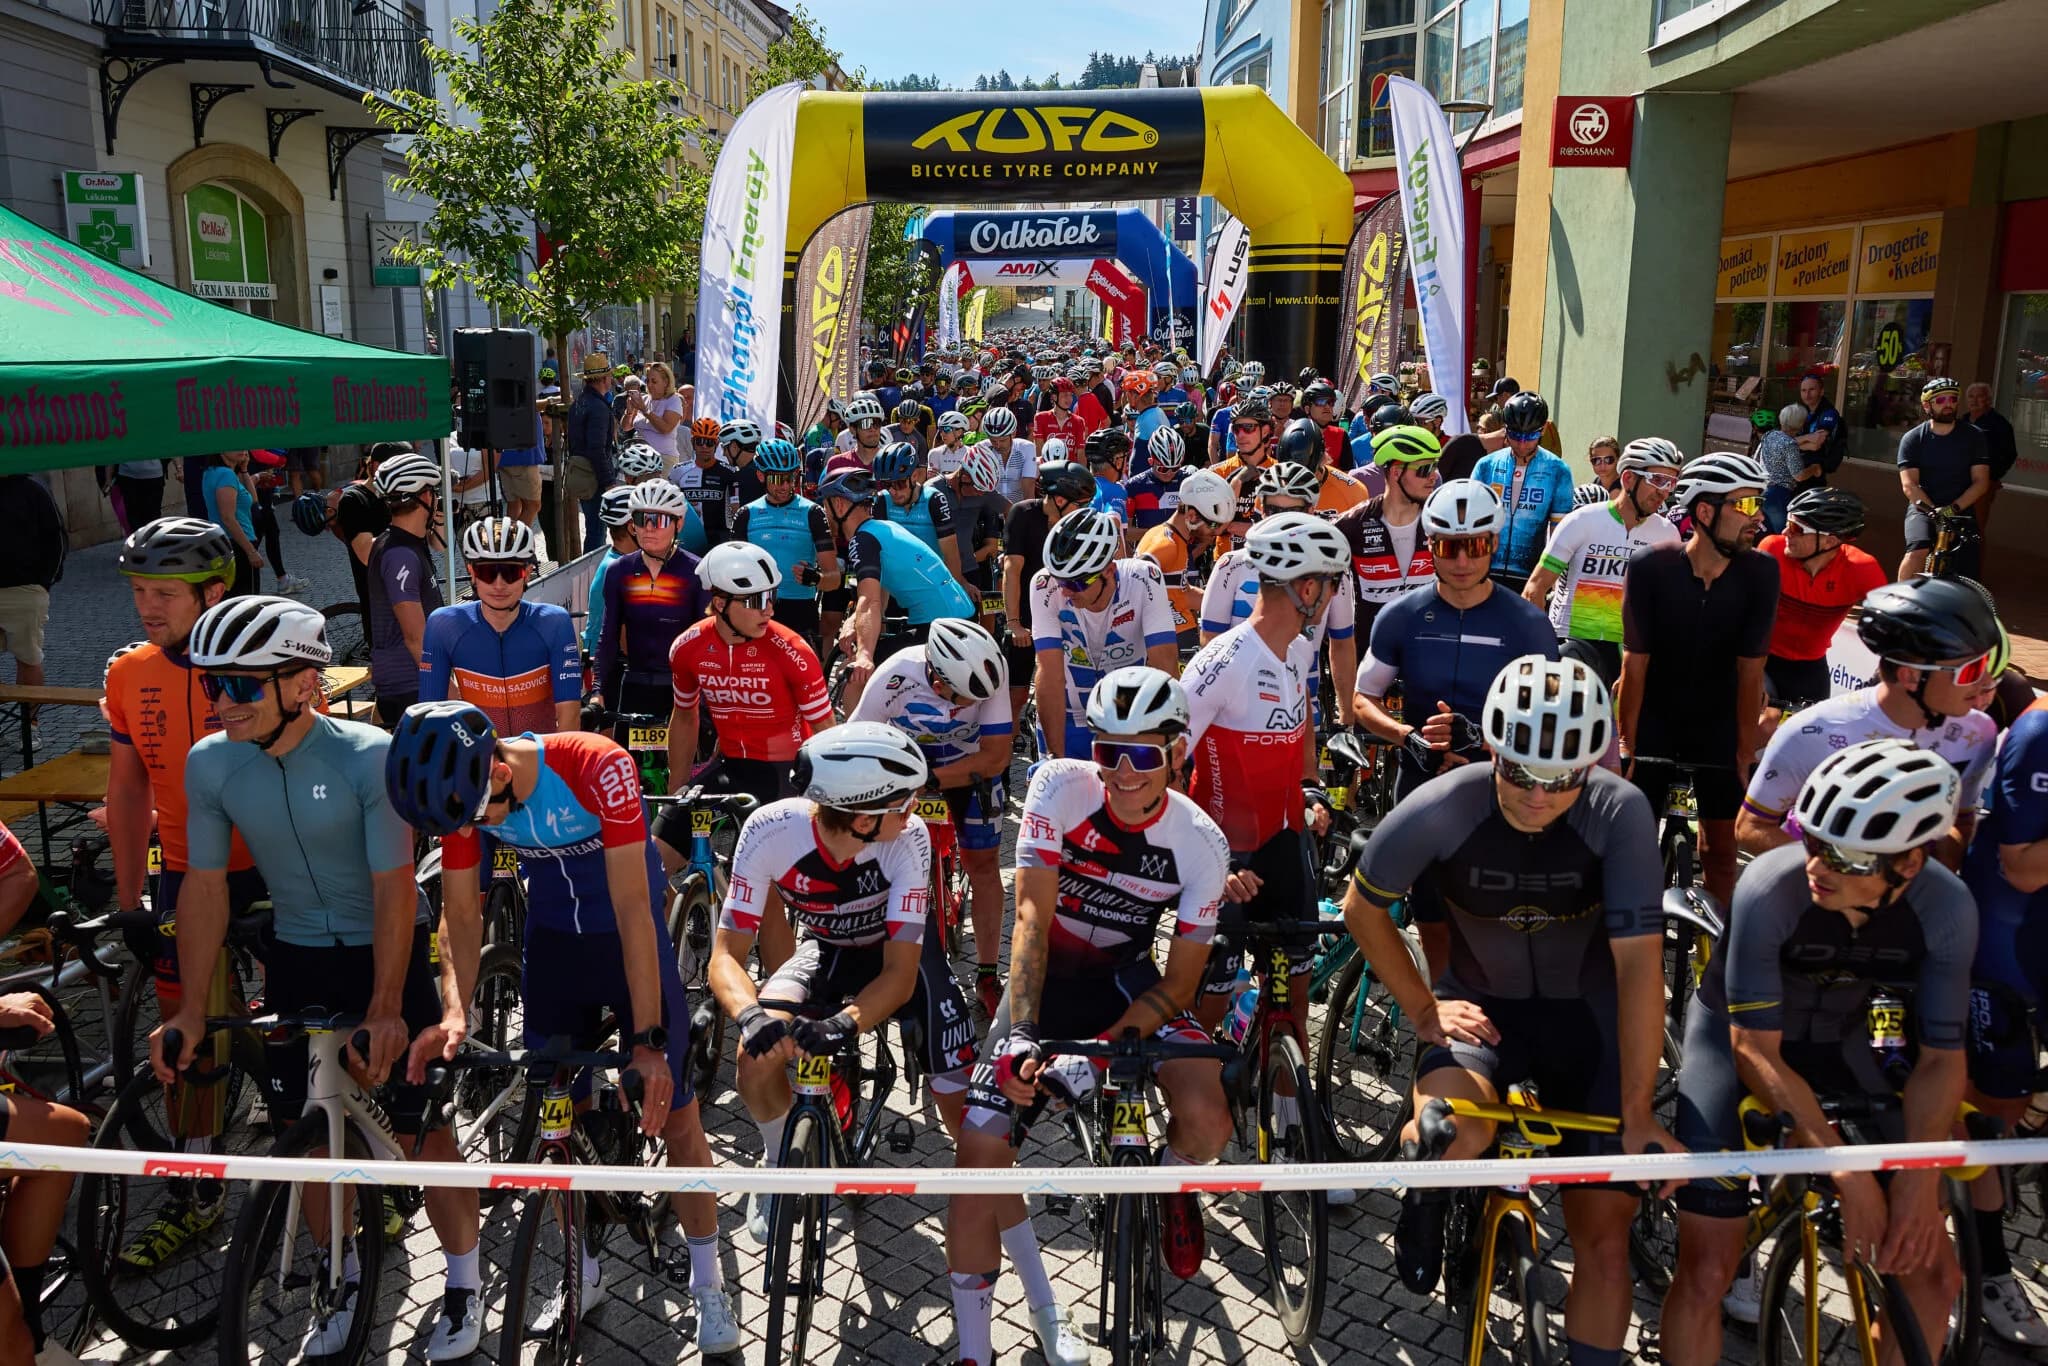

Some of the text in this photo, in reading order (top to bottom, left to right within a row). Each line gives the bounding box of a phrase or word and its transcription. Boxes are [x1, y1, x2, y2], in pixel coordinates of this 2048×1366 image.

[1559, 146, 1615, 157] ROSSMANN
[911, 161, 1159, 178] BICYCLE TYRE COMPANY
[85, 177, 116, 187] Dr.Max
[731, 148, 770, 283] Energy
[201, 220, 227, 237] Dr.Max
[969, 214, 1100, 253] Odkolek
[1784, 240, 1830, 270] Záclony
[1868, 226, 1929, 265] Drogerie
[1730, 261, 1769, 294] potřeby
[1798, 254, 1849, 287] Povlečení
[224, 285, 237, 297] NA
[1153, 324, 1195, 341] Odolek
[686, 490, 720, 500] KASPER
[281, 639, 331, 661] S-WORKS
[1195, 636, 1245, 698] PORGEST
[463, 678, 482, 690] BIKE
[481, 683, 505, 694] TEAM
[697, 674, 770, 690] FAVORIT
[701, 687, 772, 706] BRNO
[632, 729, 667, 742] 1189
[826, 781, 896, 804] S-WORKS
[1083, 903, 1132, 923] TRADING
[1132, 914, 1149, 925] CZ
